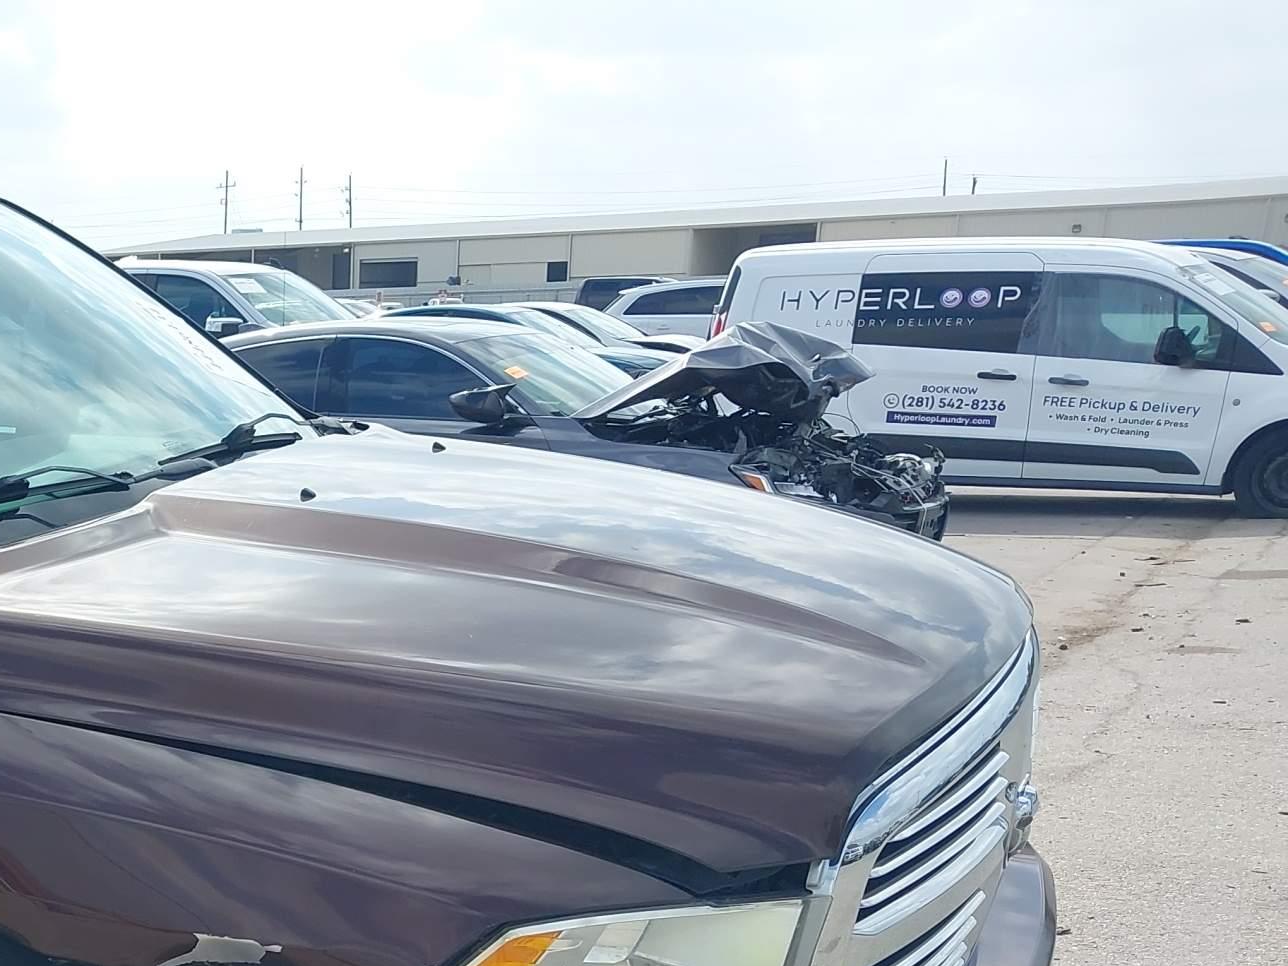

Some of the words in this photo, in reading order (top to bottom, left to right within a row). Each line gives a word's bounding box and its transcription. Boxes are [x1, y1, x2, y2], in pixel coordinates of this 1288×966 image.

[816, 318, 887, 328] LAUNDRY
[896, 317, 976, 328] DELIVERY
[921, 384, 950, 394] BOOK
[952, 386, 978, 395] NOW
[901, 394, 935, 410] (281)
[938, 397, 1006, 411] 542-8236
[1042, 395, 1077, 408] FREE
[1079, 397, 1126, 414] Pickup
[1129, 400, 1138, 412] &
[1141, 401, 1201, 418] Delivery
[1055, 413, 1079, 422] Wash
[1088, 415, 1107, 423] Fold
[1118, 417, 1154, 426] Launder
[1164, 419, 1189, 428] Press
[1094, 426, 1109, 435] Dry
[1110, 427, 1150, 439] Cleaning
